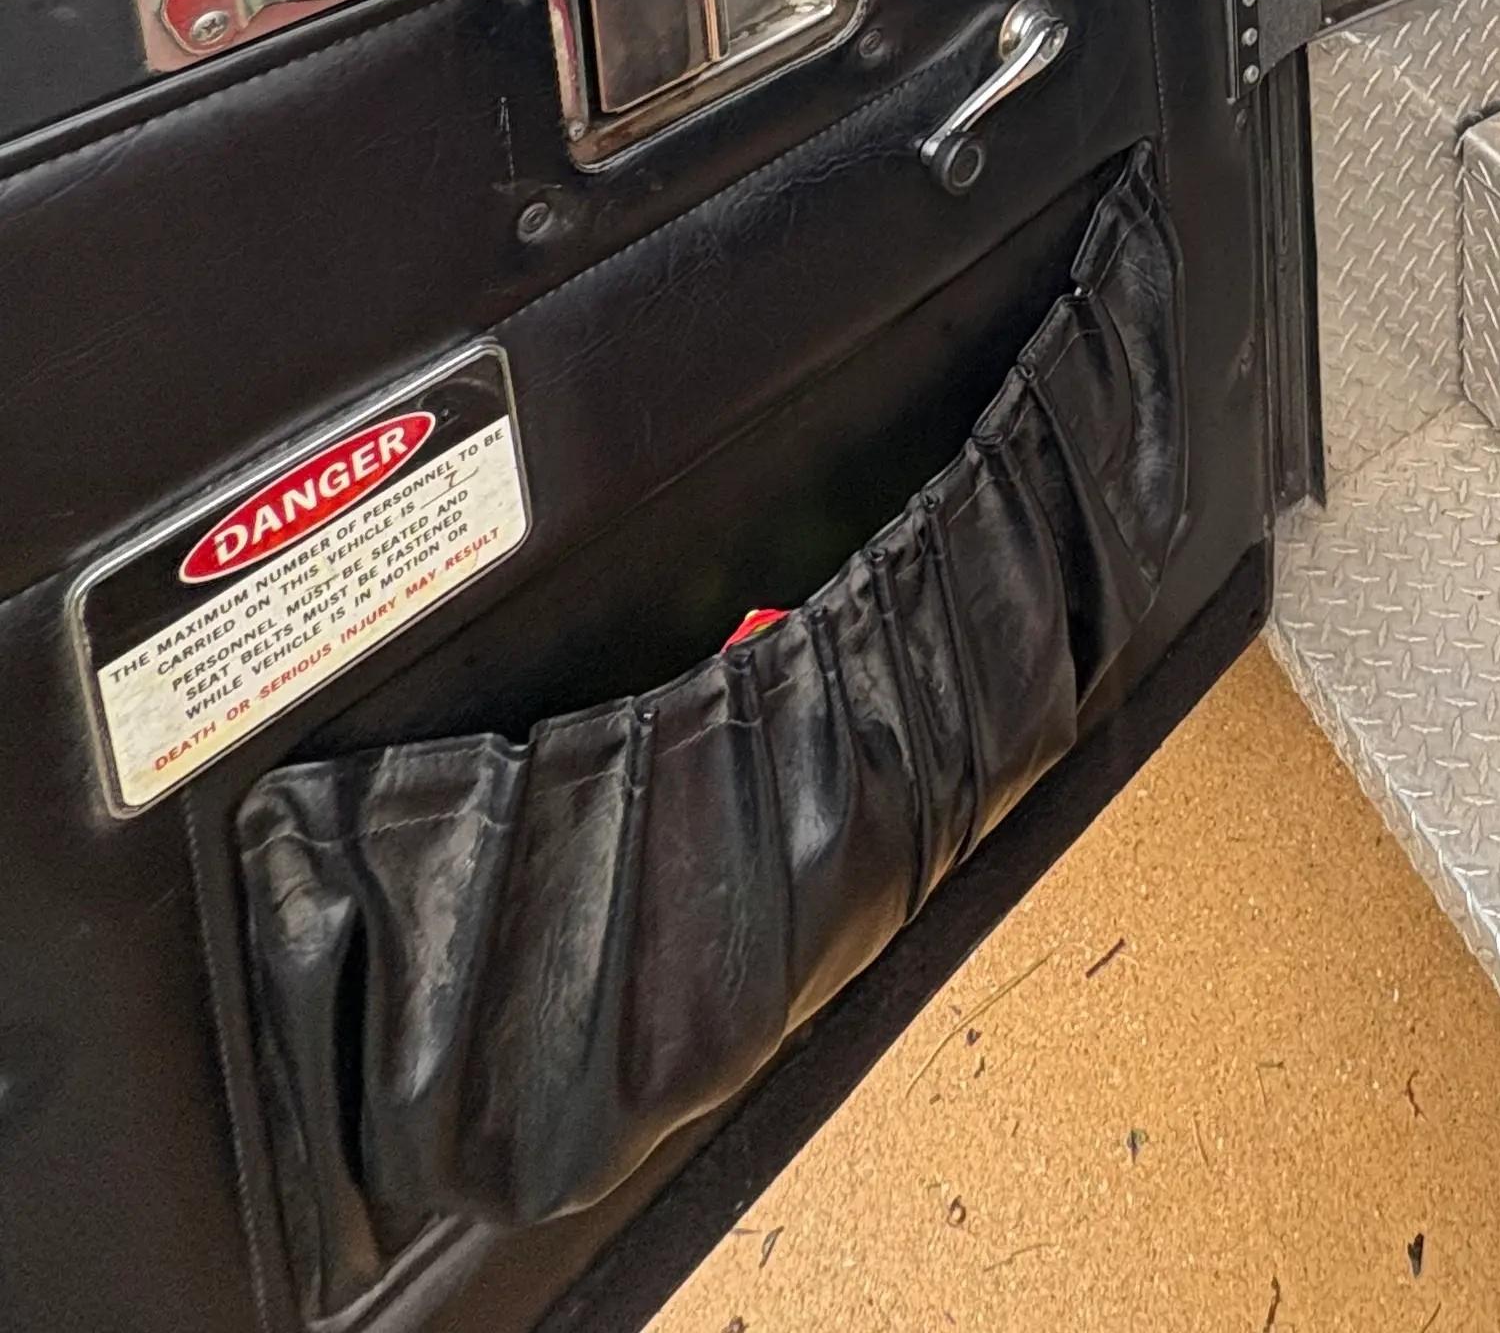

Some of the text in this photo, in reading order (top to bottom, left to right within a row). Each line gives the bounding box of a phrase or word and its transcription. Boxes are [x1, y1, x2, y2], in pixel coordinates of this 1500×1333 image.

[109, 428, 503, 683] THE MAXIMUM NUMBER OF PERSONNEL TO BE
[157, 619, 235, 676] CARRIED
[245, 595, 271, 619] ON
[281, 565, 319, 596] THIS
[327, 516, 393, 565] VEHICLE
[401, 501, 415, 518] IS
[172, 489, 468, 692] PERSONNEL MUST BE SEATED AND
[214, 427, 408, 566] DANGER
[155, 527, 499, 771] DEATH OR SERIOUS INJURY MAY RESULT
[185, 523, 468, 719] WHILE VEHICLE IS IN MOTION OR
[186, 510, 462, 701] SEAT BELTS MUST BE FASTENED
